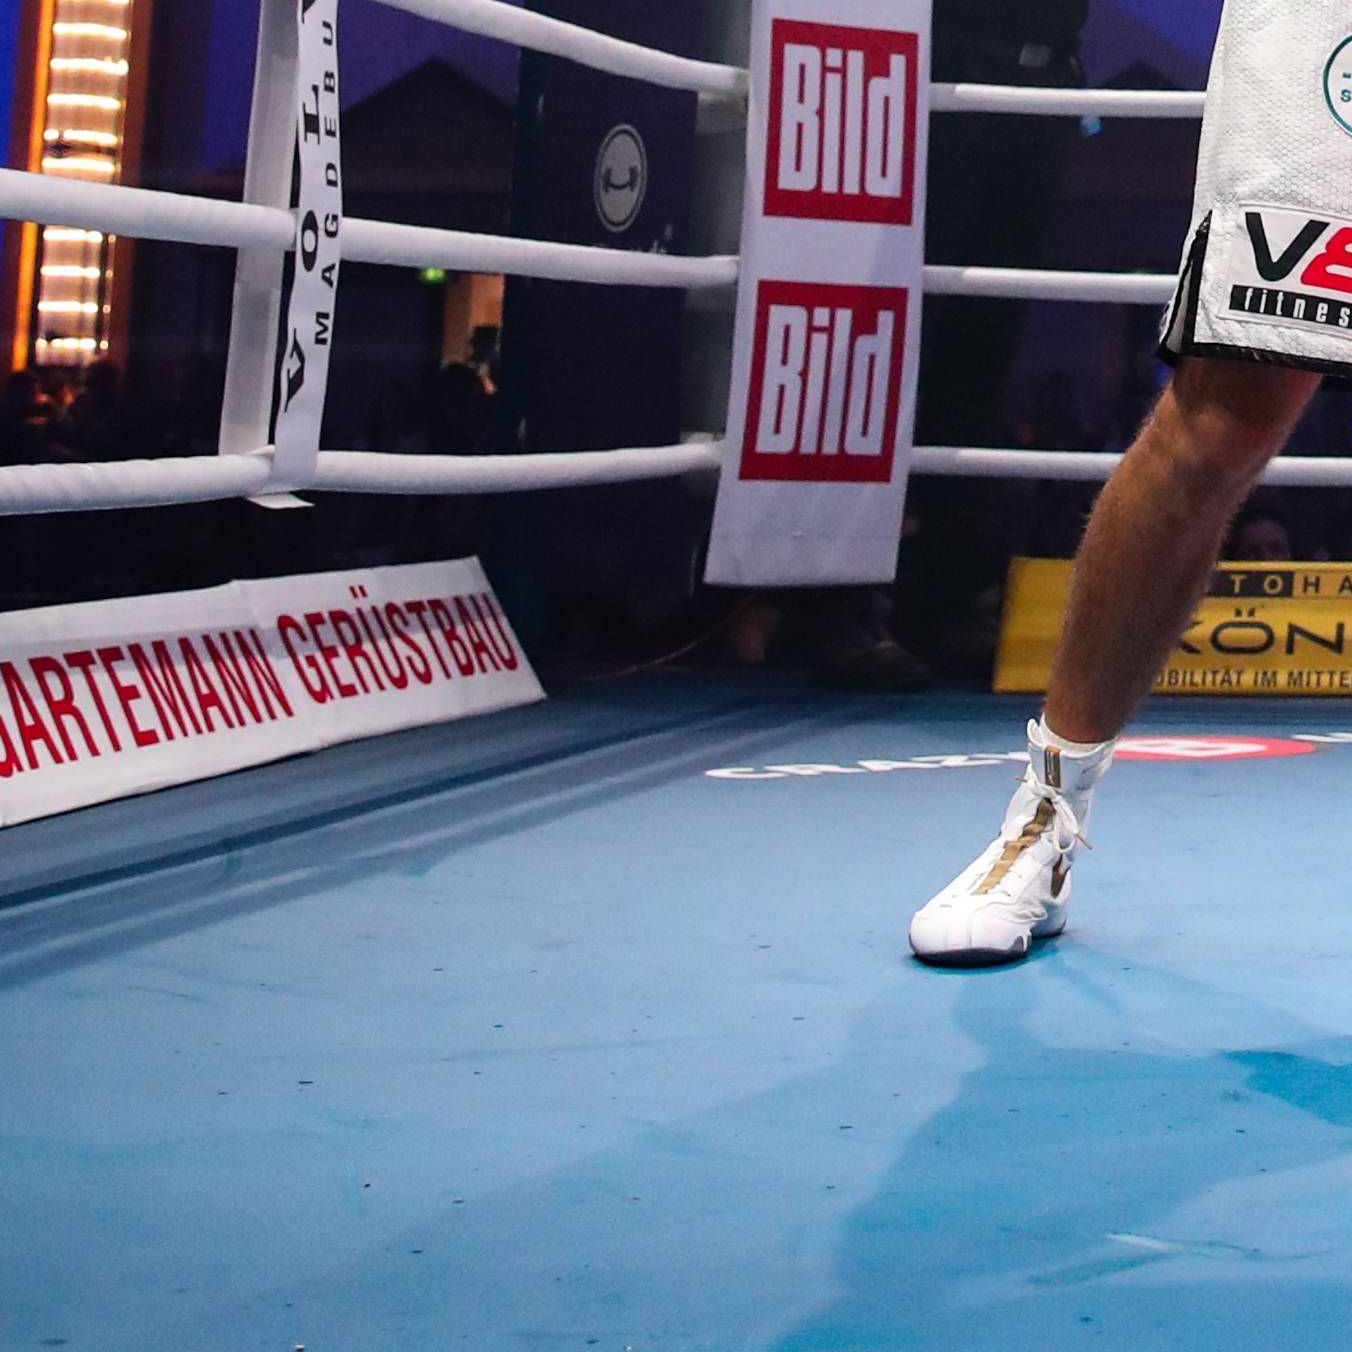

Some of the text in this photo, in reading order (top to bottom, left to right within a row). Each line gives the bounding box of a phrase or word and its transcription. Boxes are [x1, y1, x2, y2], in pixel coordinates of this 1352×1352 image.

[777, 43, 907, 198] Bild
[755, 303, 895, 457] Bild
[277, 584, 519, 705] GERÜSTBAU
[1156, 666, 1245, 689] BILITÄT
[1253, 669, 1278, 689] IM
